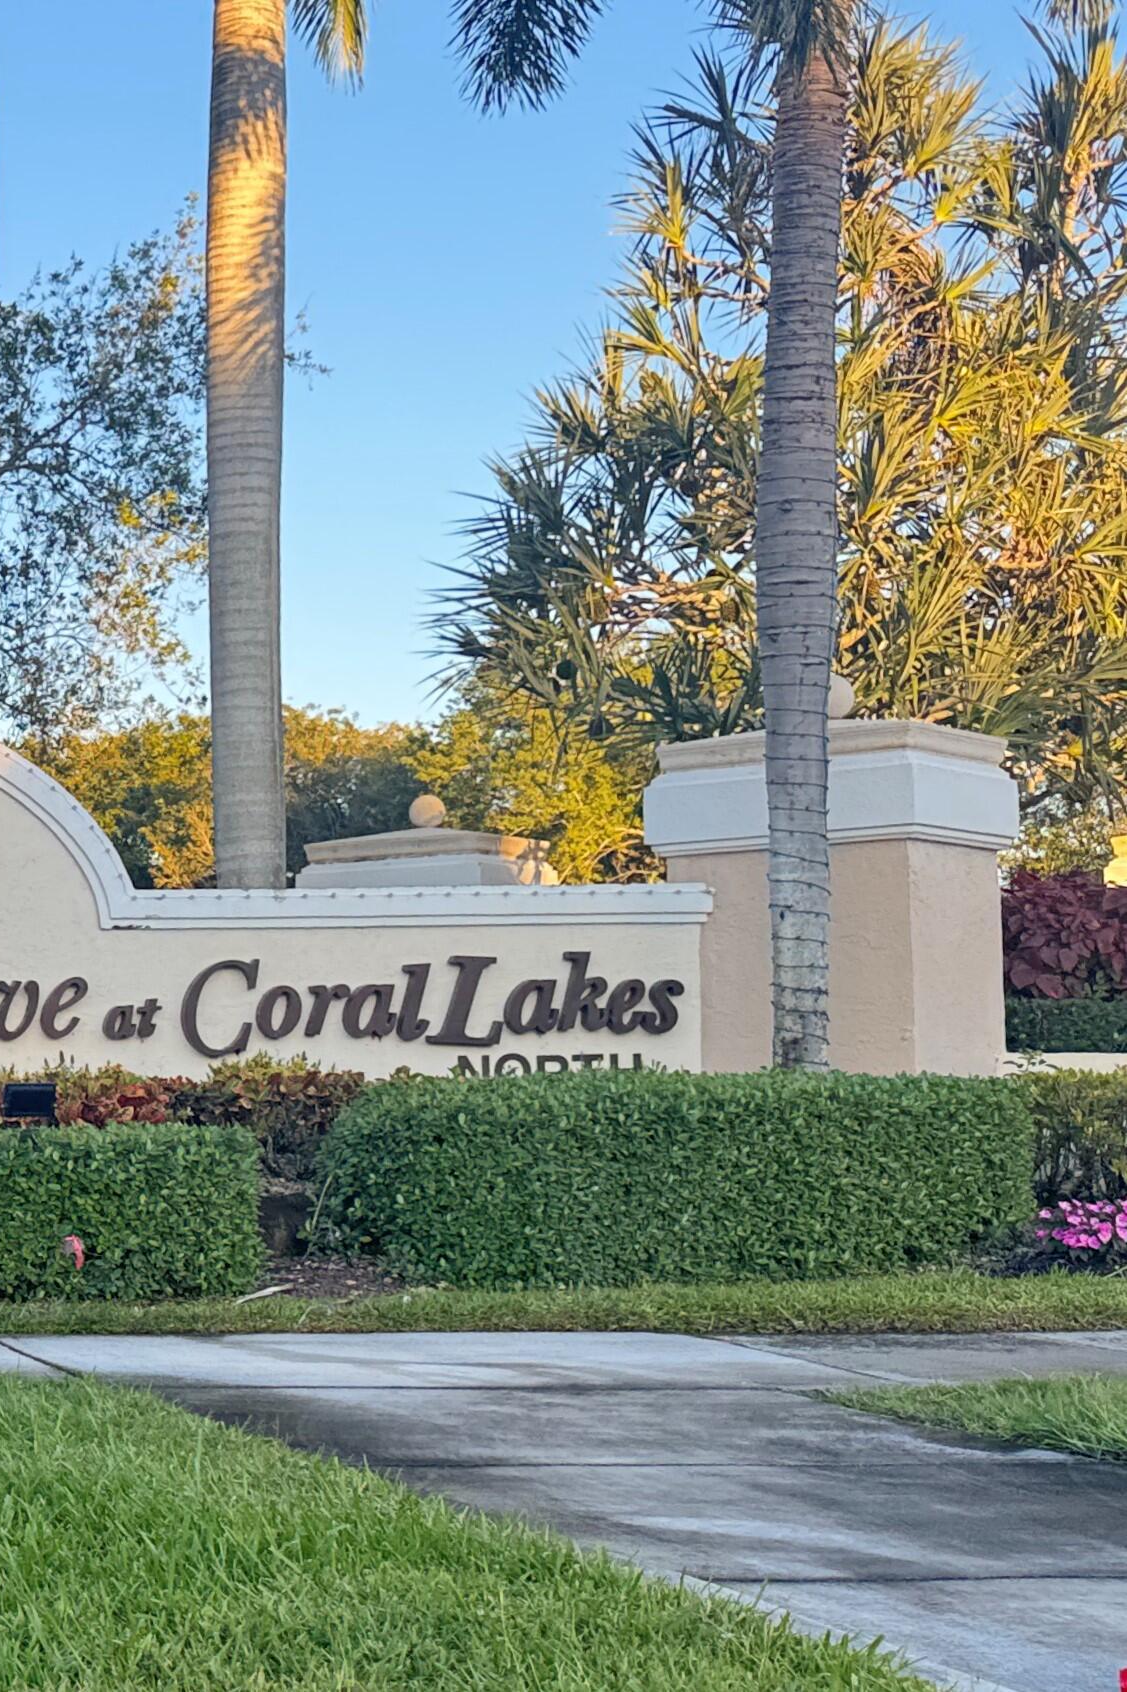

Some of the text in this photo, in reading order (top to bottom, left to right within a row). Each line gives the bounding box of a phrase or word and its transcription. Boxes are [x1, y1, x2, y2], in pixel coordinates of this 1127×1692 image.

[102, 998, 161, 1040] at
[180, 957, 431, 1058] Coral
[425, 951, 685, 1047] Lakes
